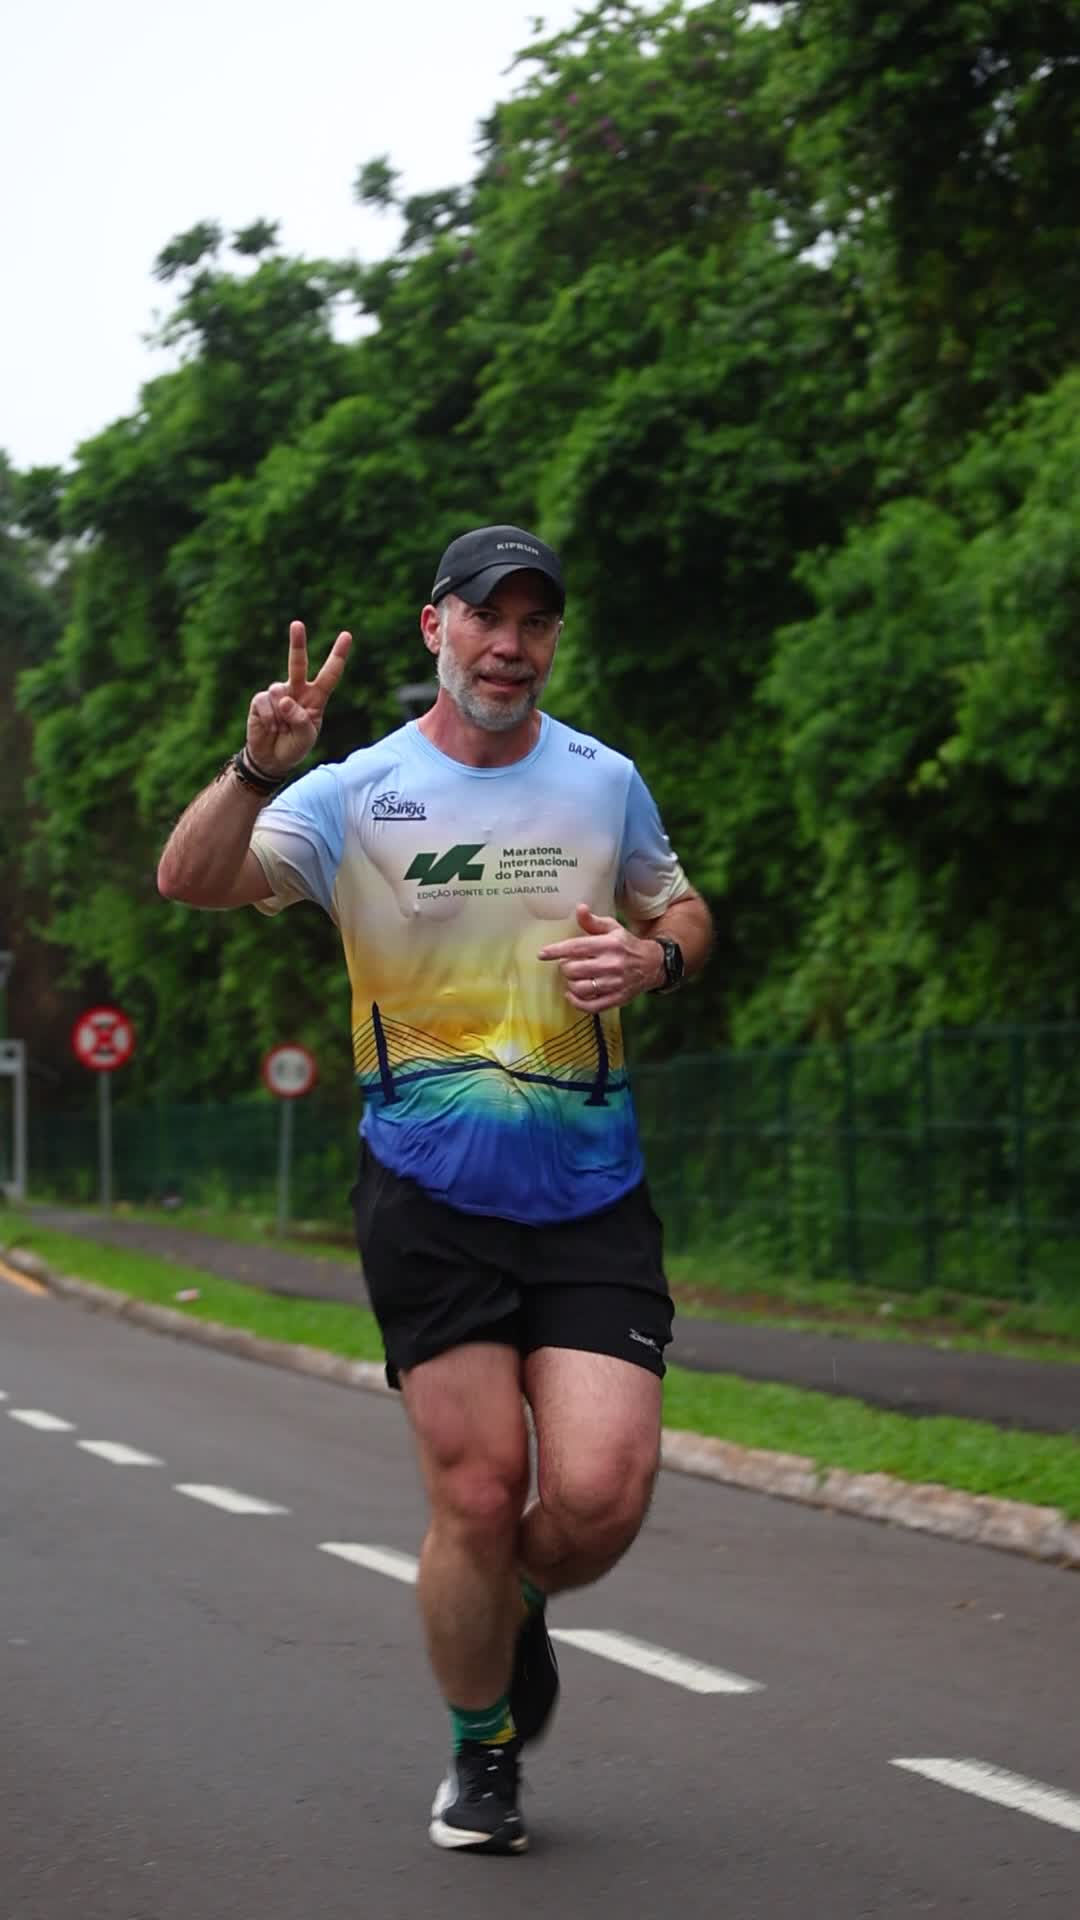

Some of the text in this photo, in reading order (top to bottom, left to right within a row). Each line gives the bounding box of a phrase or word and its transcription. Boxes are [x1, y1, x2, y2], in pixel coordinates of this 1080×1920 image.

[496, 542, 540, 555] KIPRUN
[568, 742, 597, 760] BAZX
[503, 847, 562, 857] Maratona
[499, 857, 578, 868] Internacional
[495, 869, 558, 880] do Paraná
[452, 889, 484, 897] PONTE
[486, 888, 499, 896] DE
[503, 885, 560, 895] GUARATUBA
